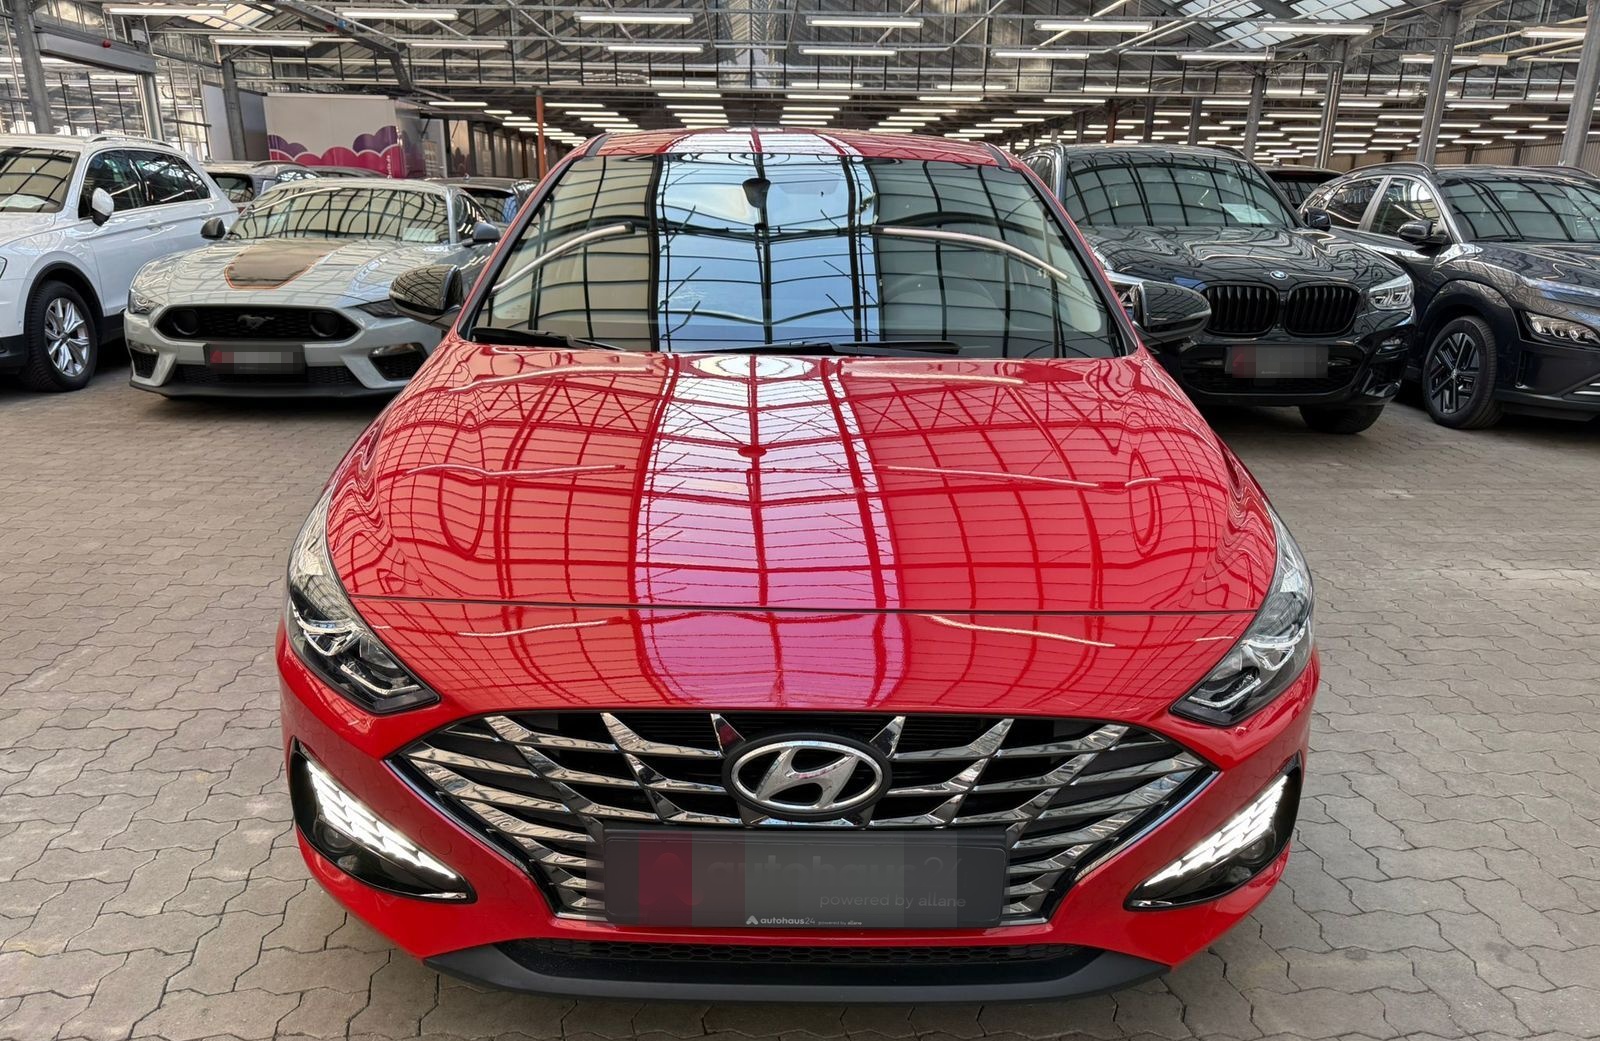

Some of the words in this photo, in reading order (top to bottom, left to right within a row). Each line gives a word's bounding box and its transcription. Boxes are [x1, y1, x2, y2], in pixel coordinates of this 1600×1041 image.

[820, 892, 889, 908] powered
[895, 893, 913, 909] by
[918, 892, 966, 908] allane
[760, 916, 815, 925] autohaus24
